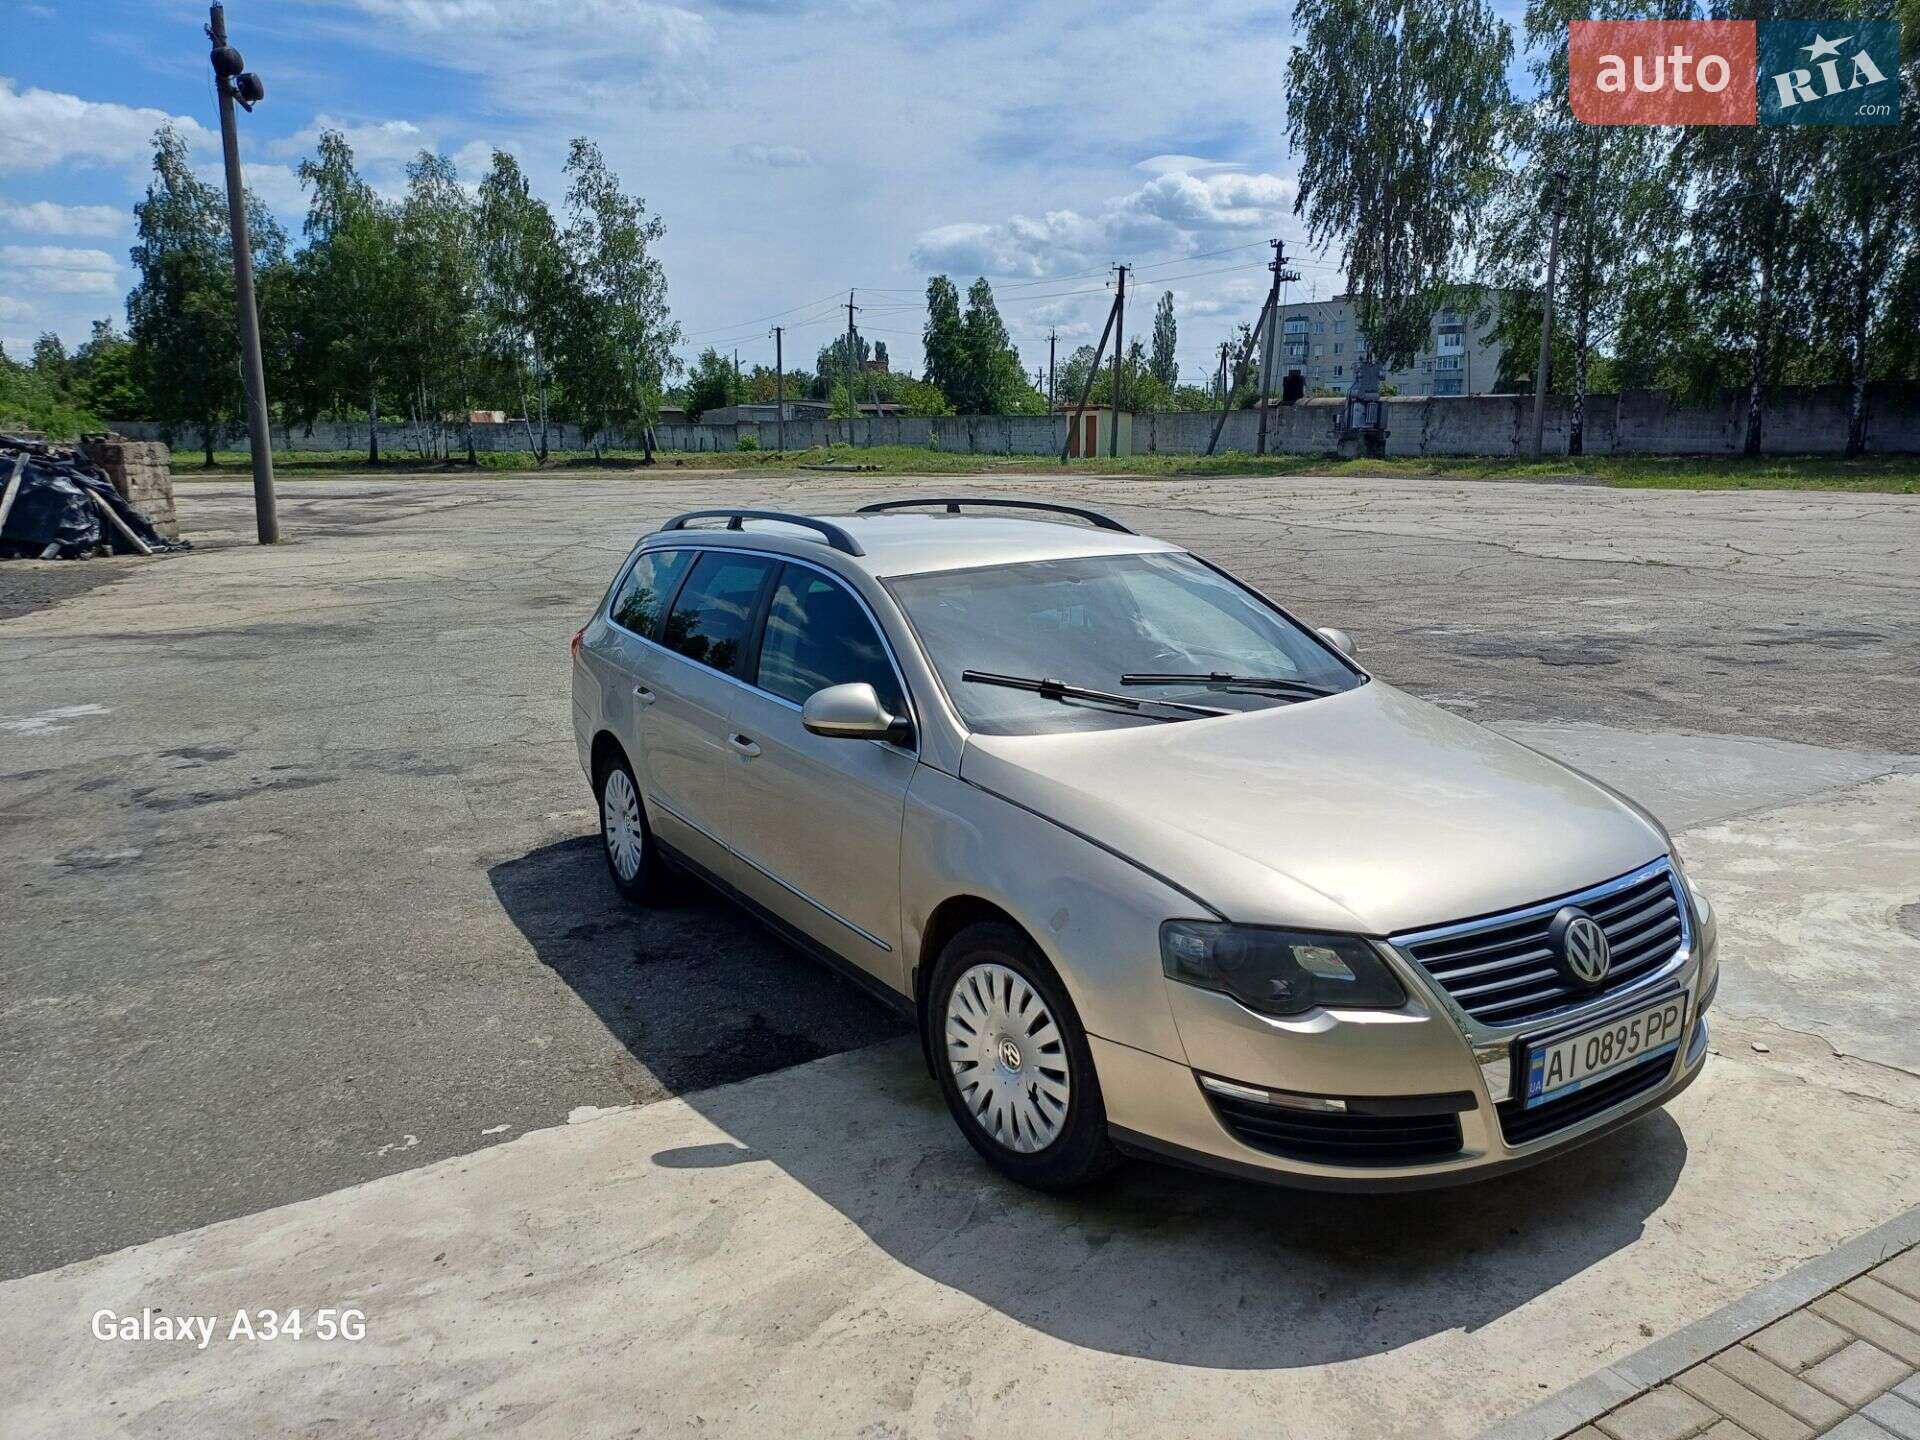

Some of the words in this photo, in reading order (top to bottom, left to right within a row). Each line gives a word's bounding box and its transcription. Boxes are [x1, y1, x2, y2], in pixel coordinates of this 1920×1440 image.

[1545, 1044, 1577, 1087] AI
[1585, 1016, 1642, 1070] 0895
[1645, 1005, 1678, 1046] PP
